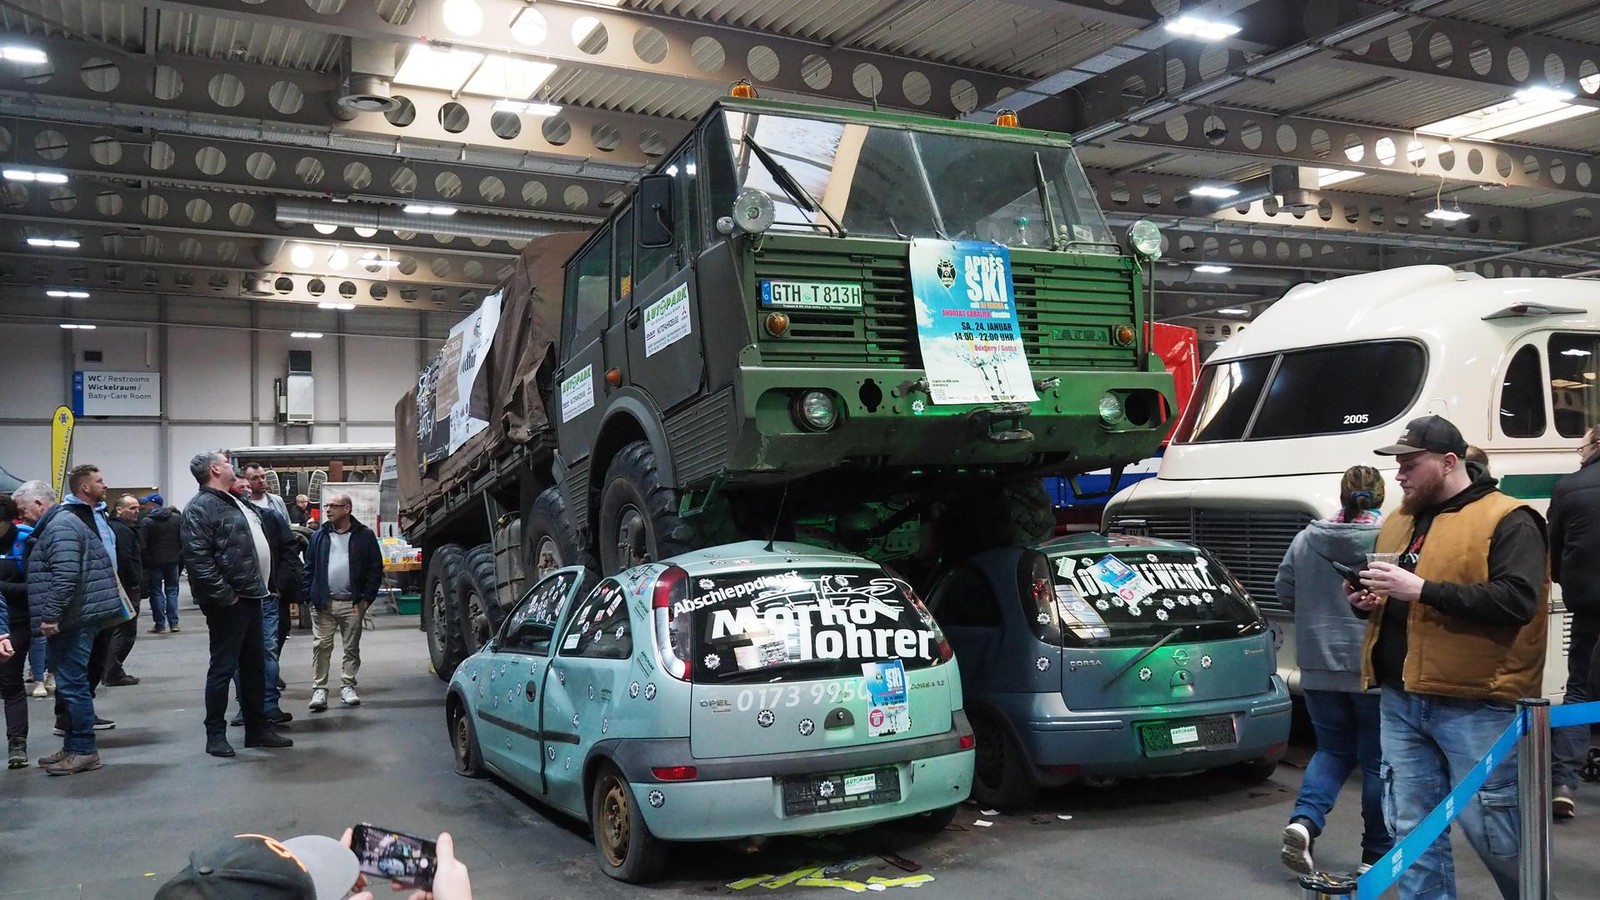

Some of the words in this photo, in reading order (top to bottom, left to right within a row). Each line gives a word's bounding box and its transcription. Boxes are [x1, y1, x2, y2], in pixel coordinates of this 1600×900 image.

[965, 254, 1004, 272] APRÈS
[772, 284, 801, 302] GTH
[811, 286, 819, 302] T
[965, 270, 1008, 302] SKI
[646, 286, 686, 323] AUTOPARK
[987, 322, 1012, 331] JANUAR
[955, 333, 974, 341] 14:00
[980, 333, 998, 341] 22:00
[1001, 333, 1014, 341] UHR
[1343, 414, 1369, 424] 2005
[674, 570, 798, 617] Abschleppdienst
[737, 684, 800, 711] 0173
